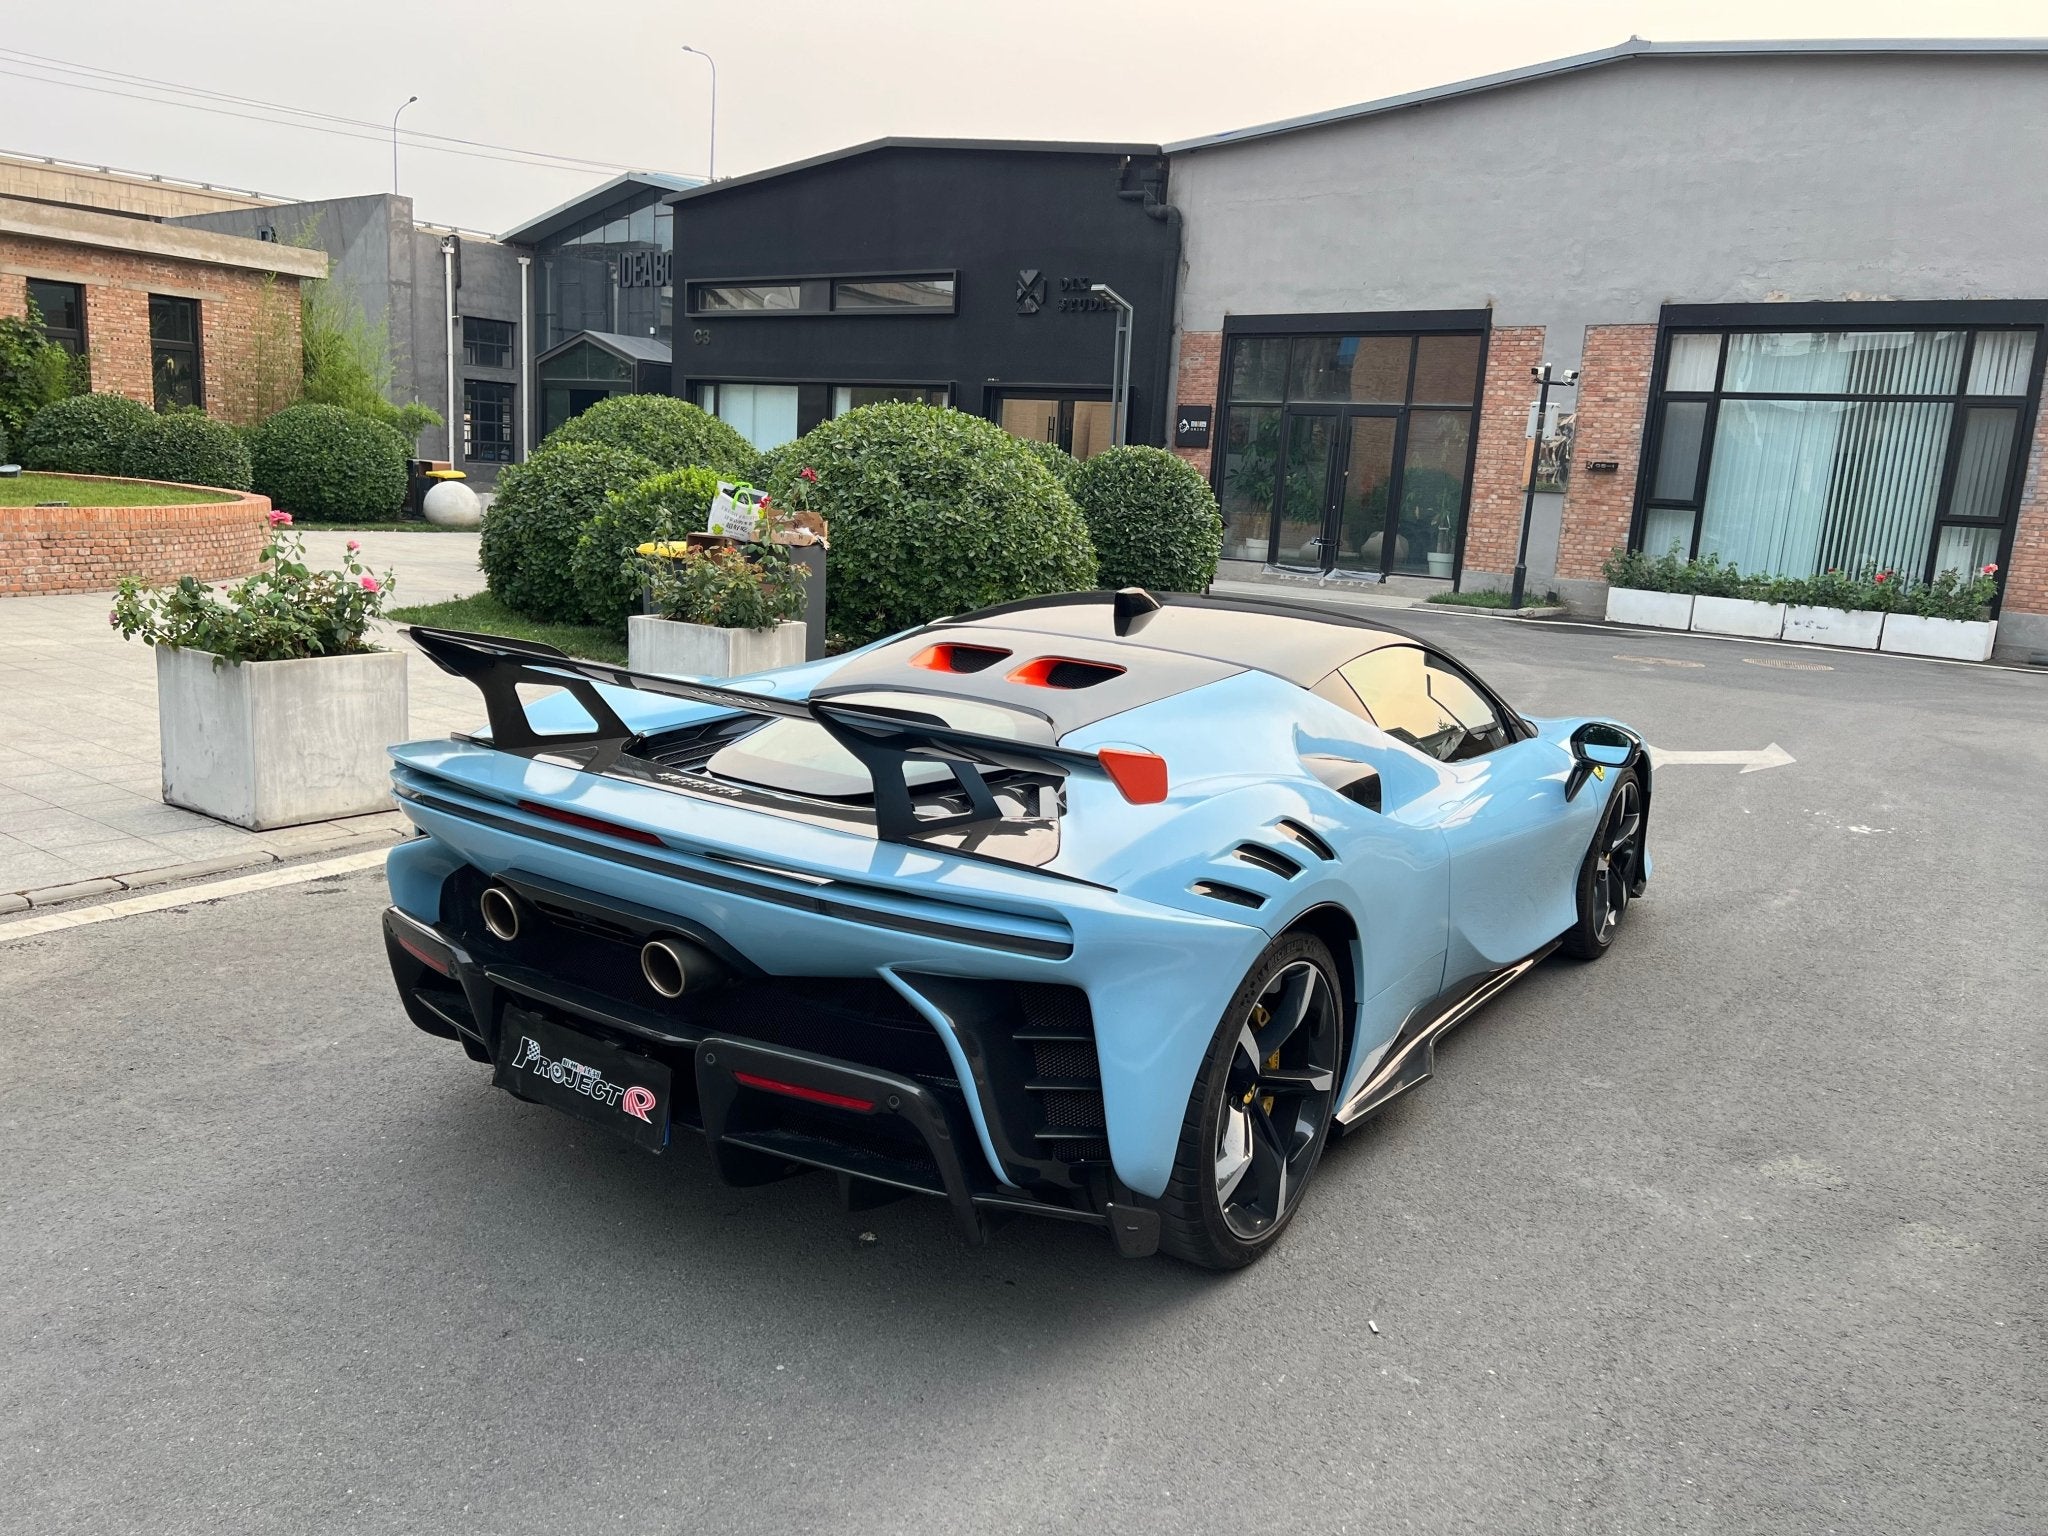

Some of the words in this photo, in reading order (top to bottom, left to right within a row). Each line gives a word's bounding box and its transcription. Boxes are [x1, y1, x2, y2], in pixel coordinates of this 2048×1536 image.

[1058, 297, 1114, 312] STUDI
[693, 328, 711, 345] C3
[512, 1036, 625, 1106] PROJECT
